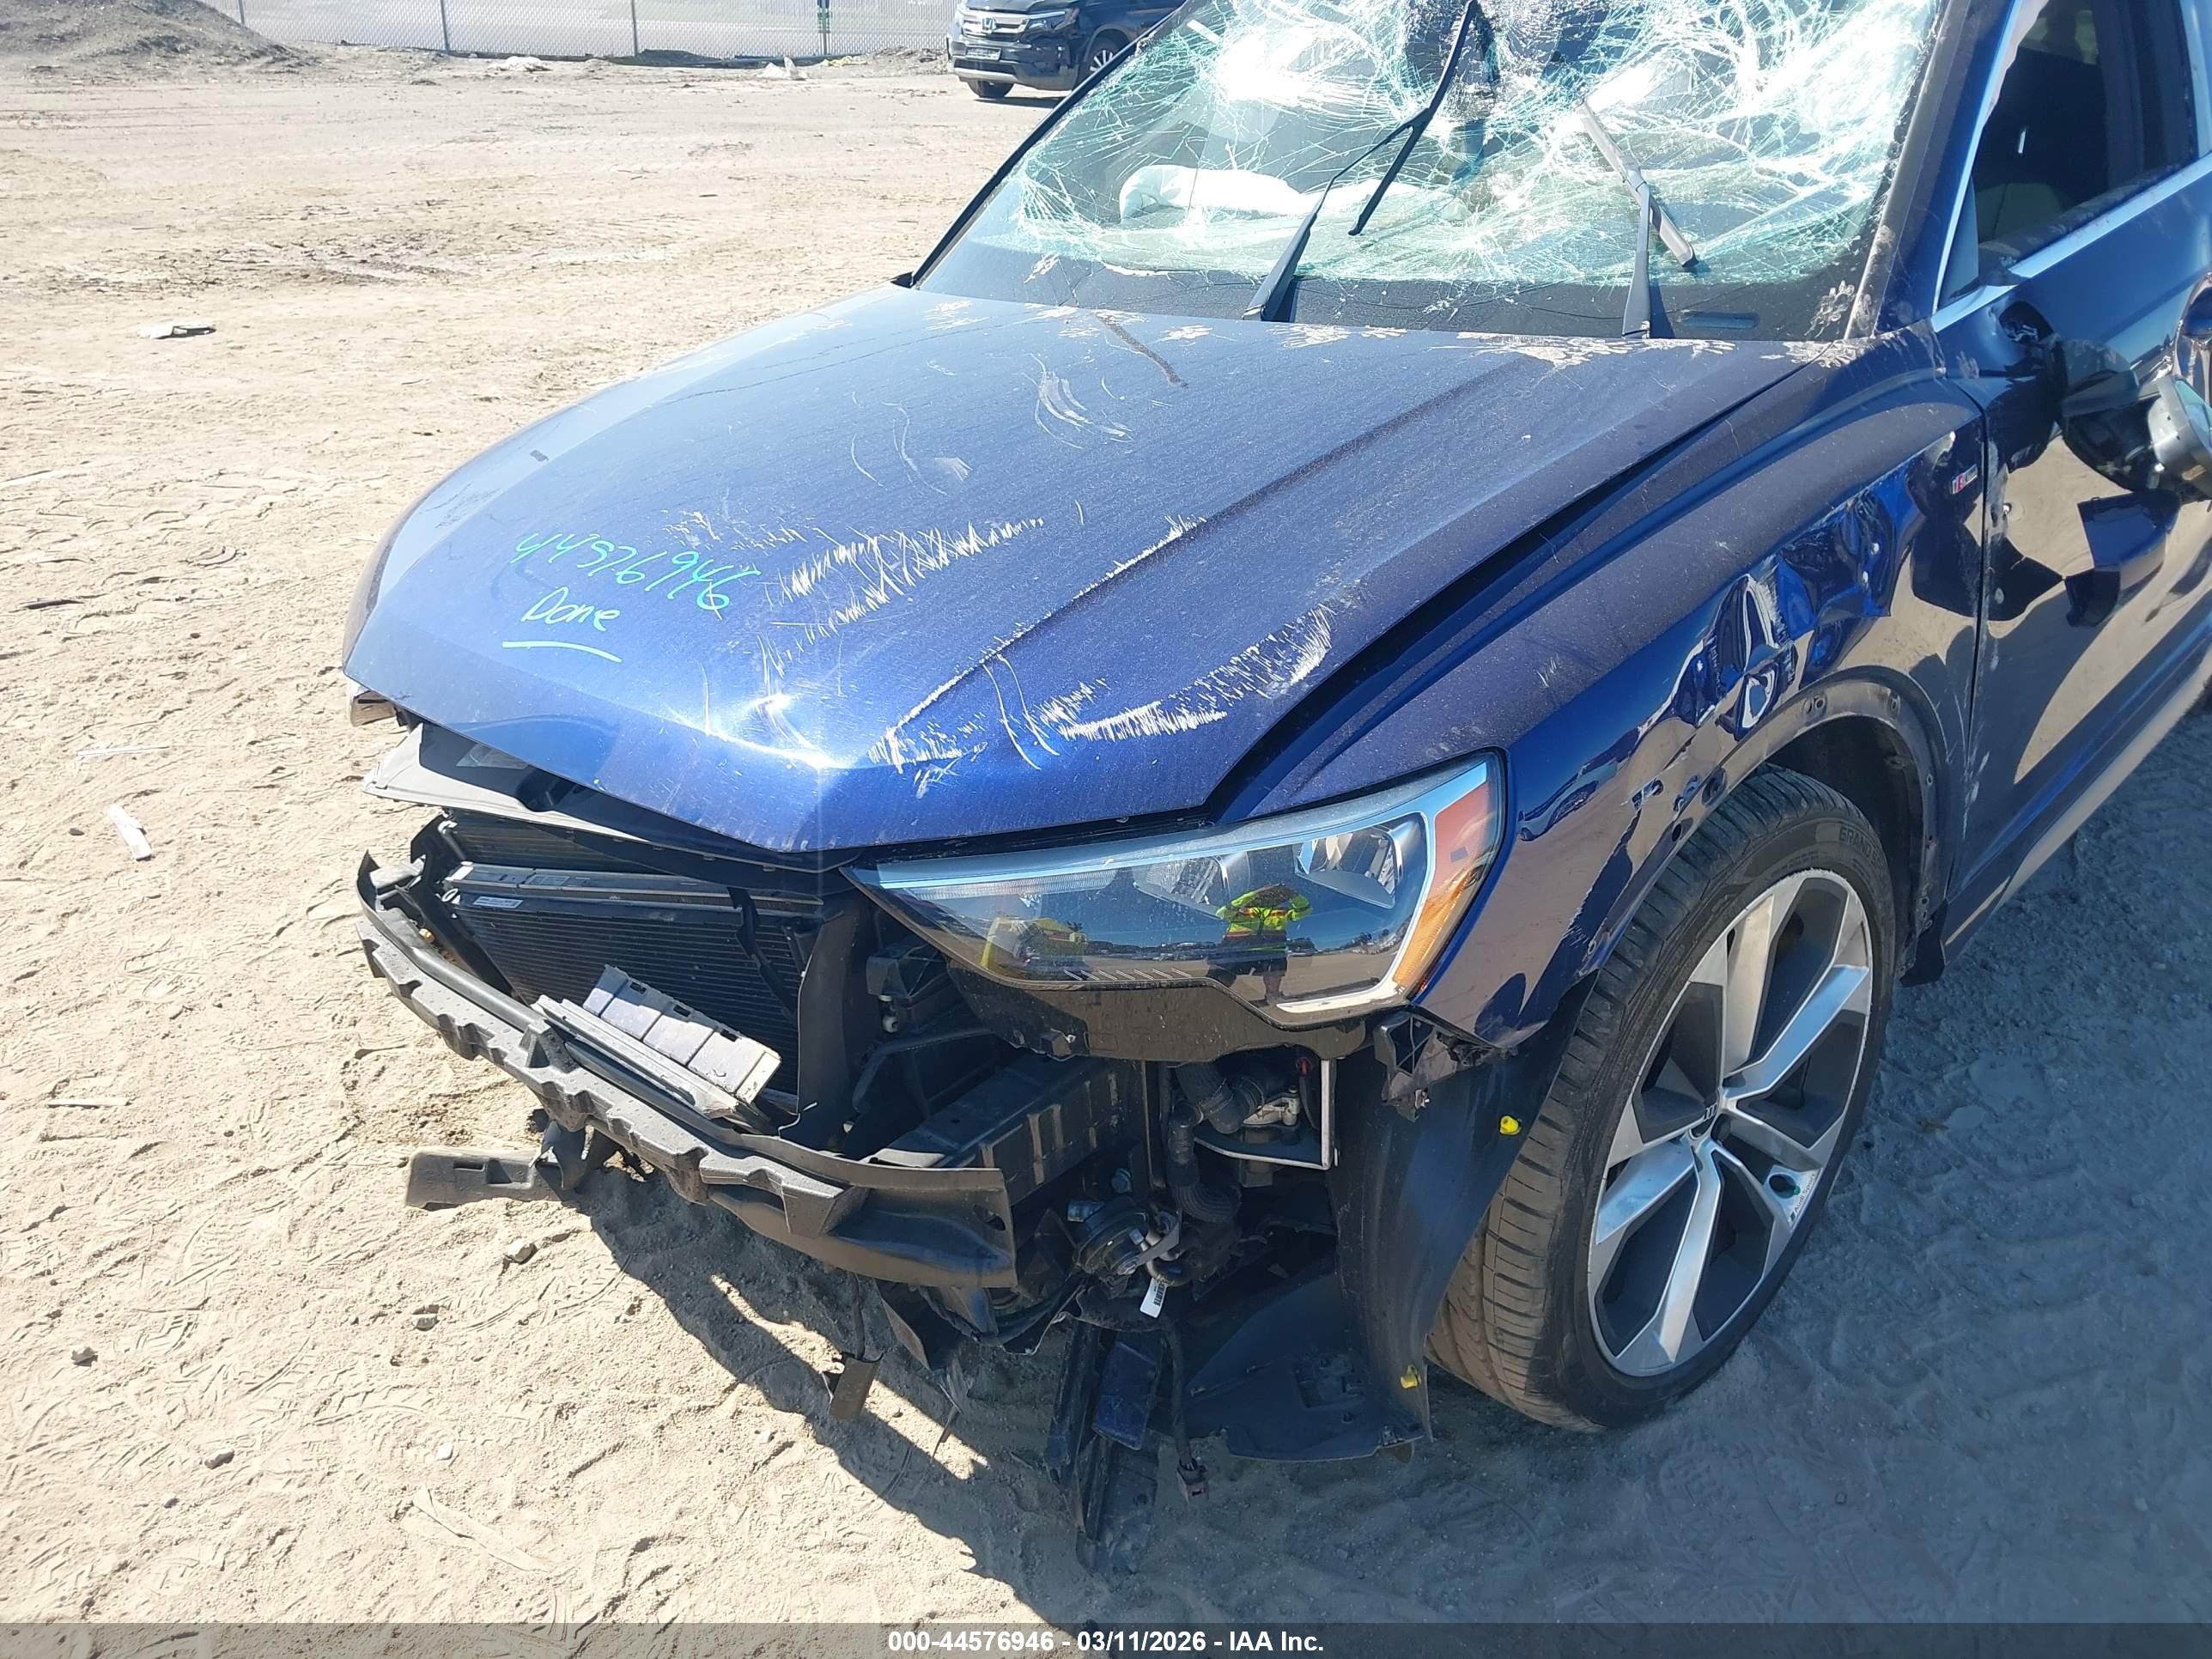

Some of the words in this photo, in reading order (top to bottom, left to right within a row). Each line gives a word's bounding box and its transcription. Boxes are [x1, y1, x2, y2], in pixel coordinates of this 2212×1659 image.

[510, 532, 762, 611] 44576946
[520, 586, 621, 632] Done
[1794, 1195, 1805, 1212] Audi
[1802, 1173, 1816, 1196] Sport
